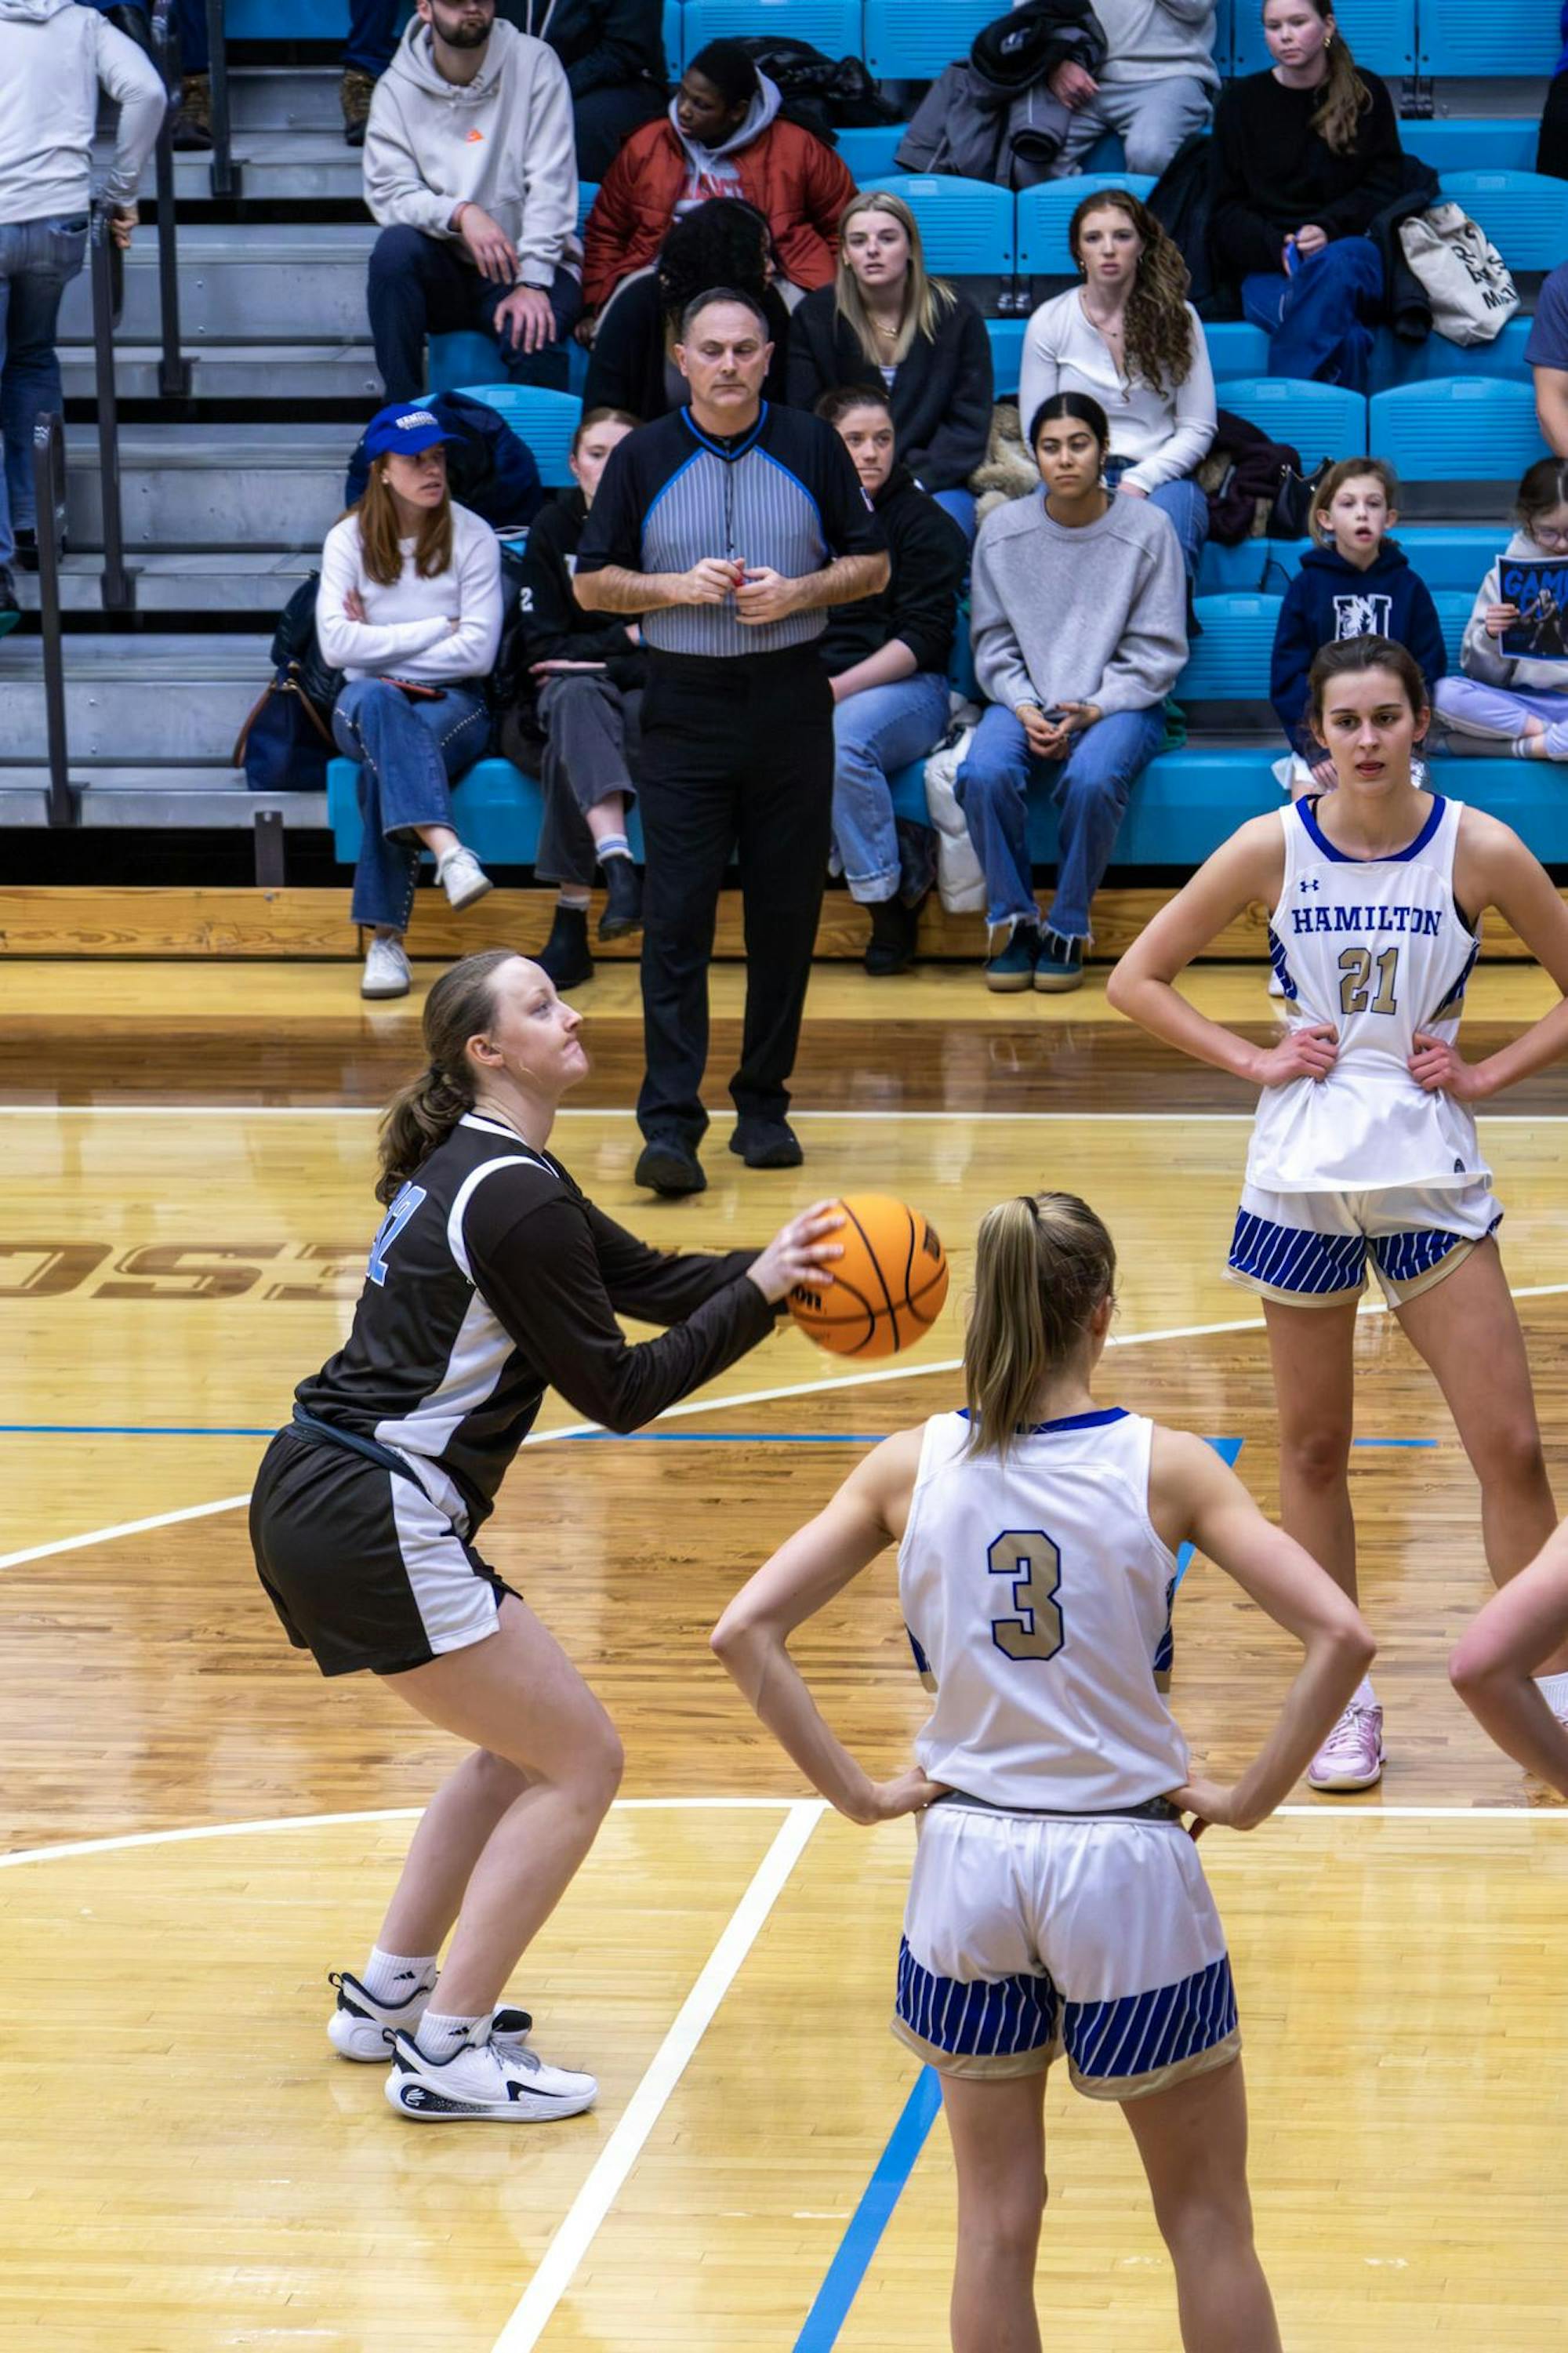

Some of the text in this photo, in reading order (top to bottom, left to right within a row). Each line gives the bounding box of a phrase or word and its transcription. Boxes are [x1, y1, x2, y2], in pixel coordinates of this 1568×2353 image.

[520, 586, 533, 612] 2
[1504, 569, 1568, 601] GAM
[1292, 906, 1443, 937] HAMILTON
[1338, 947, 1399, 1015] 21
[986, 1530, 1065, 1661] 3
